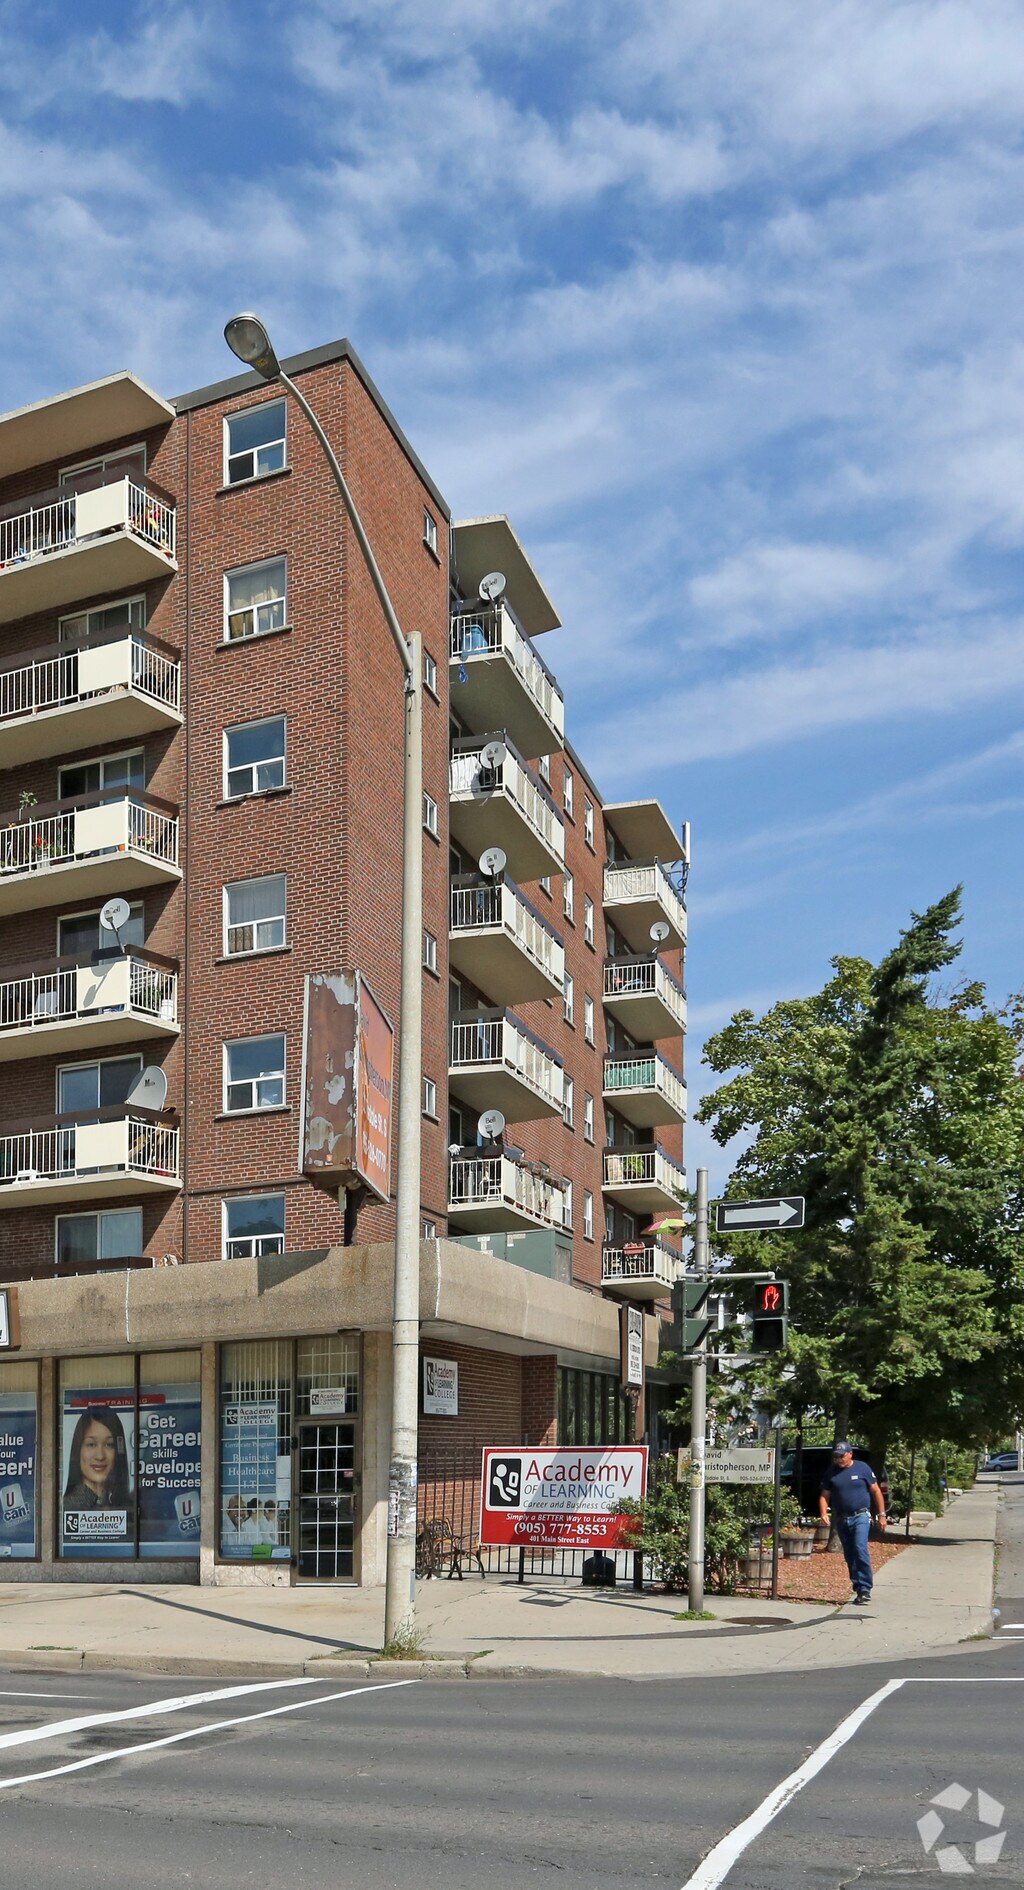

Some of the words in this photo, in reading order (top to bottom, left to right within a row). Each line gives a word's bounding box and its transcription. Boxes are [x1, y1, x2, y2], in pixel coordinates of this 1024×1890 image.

[435, 1363, 456, 1384] Academy
[435, 1389, 455, 1399] COLLEGE
[148, 1414, 176, 1429] Get
[152, 1449, 178, 1458] skills
[526, 1458, 634, 1487] Academy
[142, 1478, 155, 1487] for
[158, 1477, 201, 1488] Succes
[524, 1485, 538, 1494] OF
[542, 1484, 614, 1498] LEARNING
[6, 1492, 15, 1508] U
[4, 1503, 30, 1522] can!
[182, 1500, 192, 1516] U
[80, 1513, 124, 1525] Academy
[506, 1513, 530, 1523] Simply
[566, 1515, 582, 1524] Way
[514, 1522, 546, 1535] (905)
[550, 1524, 607, 1536] 777-8553
